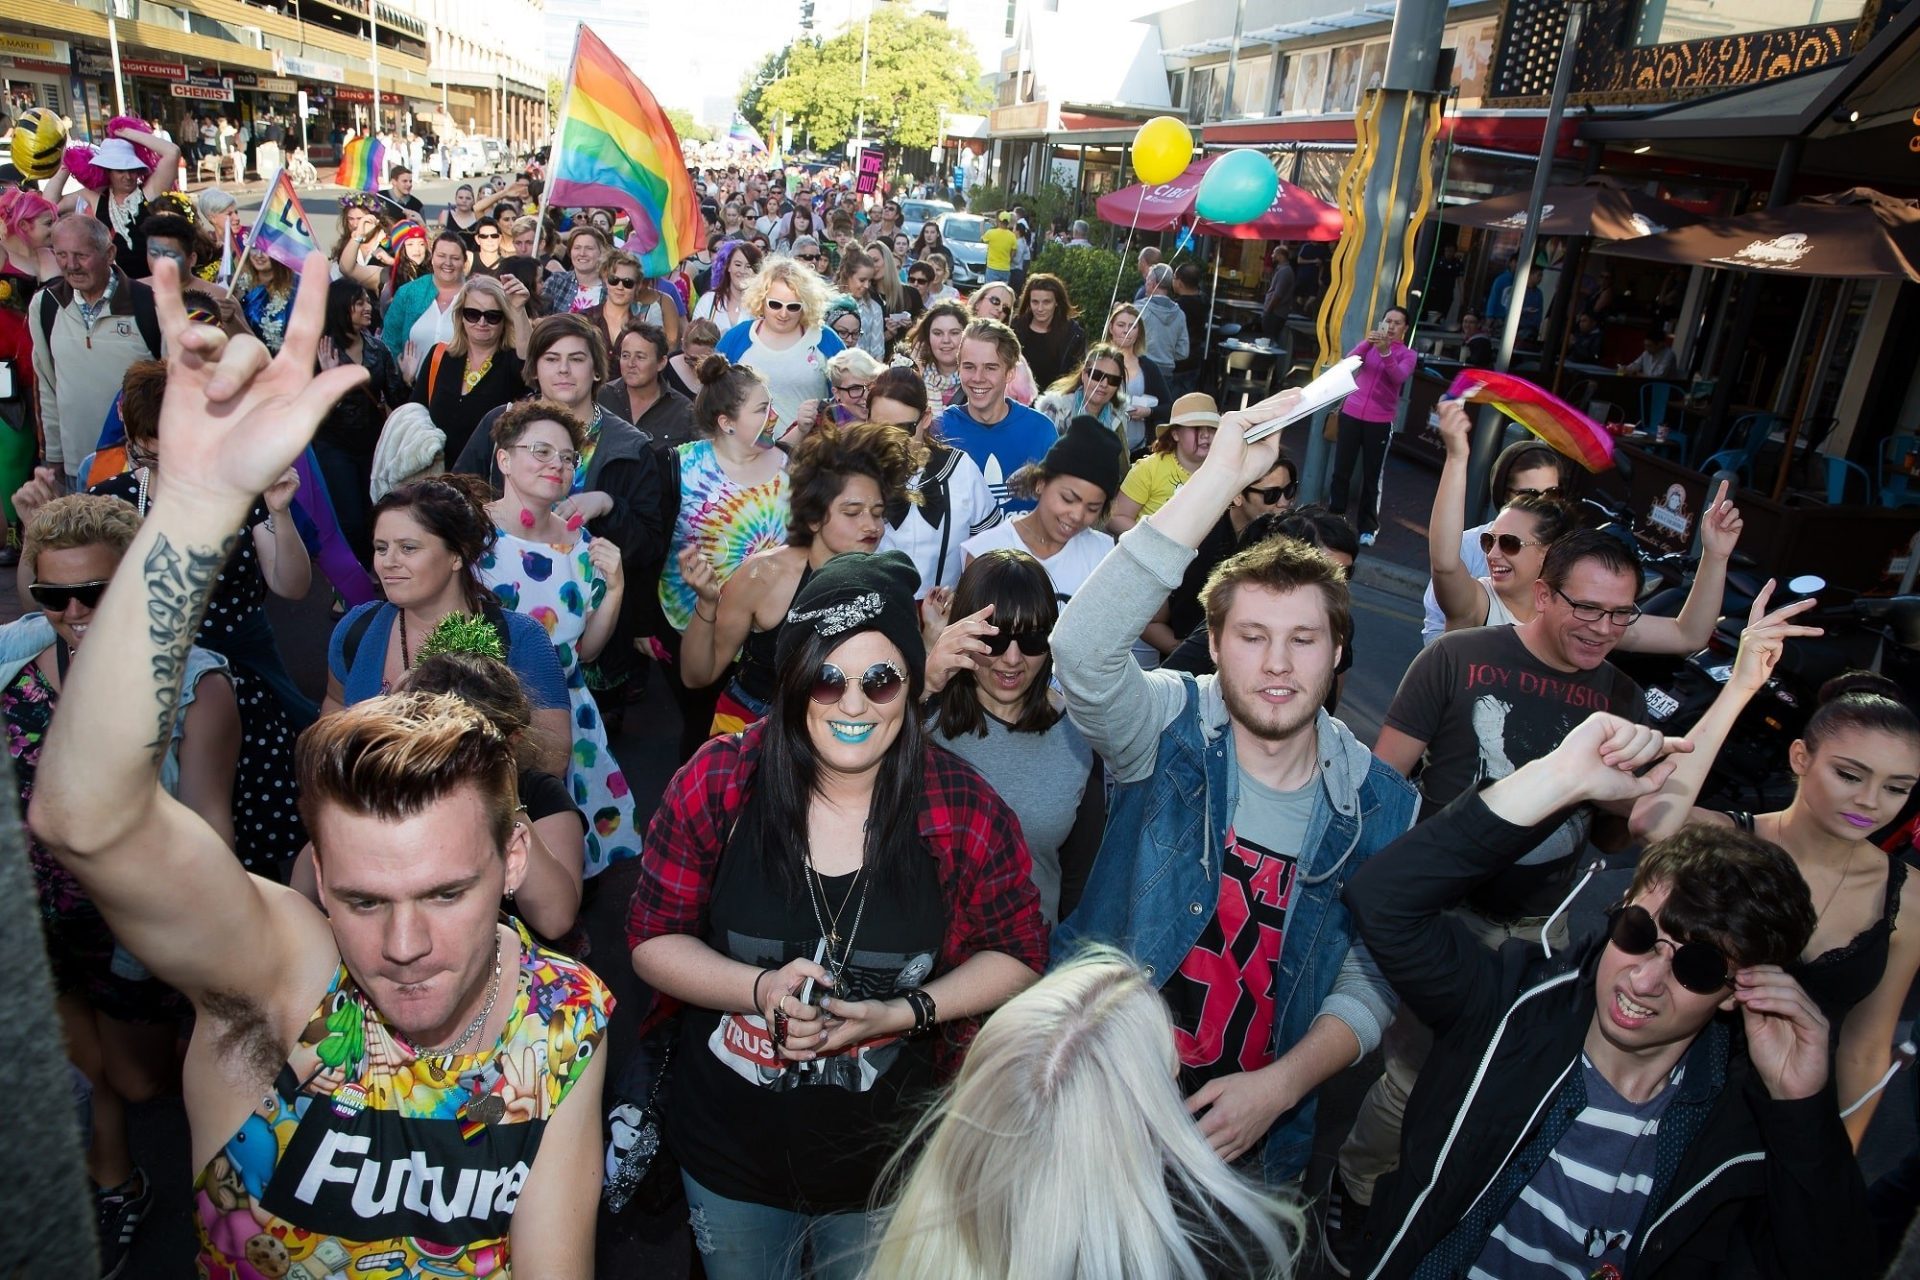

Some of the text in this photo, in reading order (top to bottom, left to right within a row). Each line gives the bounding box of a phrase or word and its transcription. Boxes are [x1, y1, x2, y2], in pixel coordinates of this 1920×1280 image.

[7, 39, 40, 50] MARKET
[122, 62, 182, 76] LIGHT CENTRE
[238, 74, 256, 84] nab
[174, 85, 231, 100] CHEMIST
[862, 155, 881, 173] COME
[859, 175, 876, 191] OUT
[1154, 184, 1191, 199] CIBO
[1465, 663, 1611, 712] JOY DIVISIO
[726, 1017, 775, 1060] TRUS
[342, 1086, 367, 1100] EQUAL
[336, 1095, 365, 1110] RIGHTS
[336, 1103, 357, 1117] NOW
[294, 1128, 530, 1223] Future
